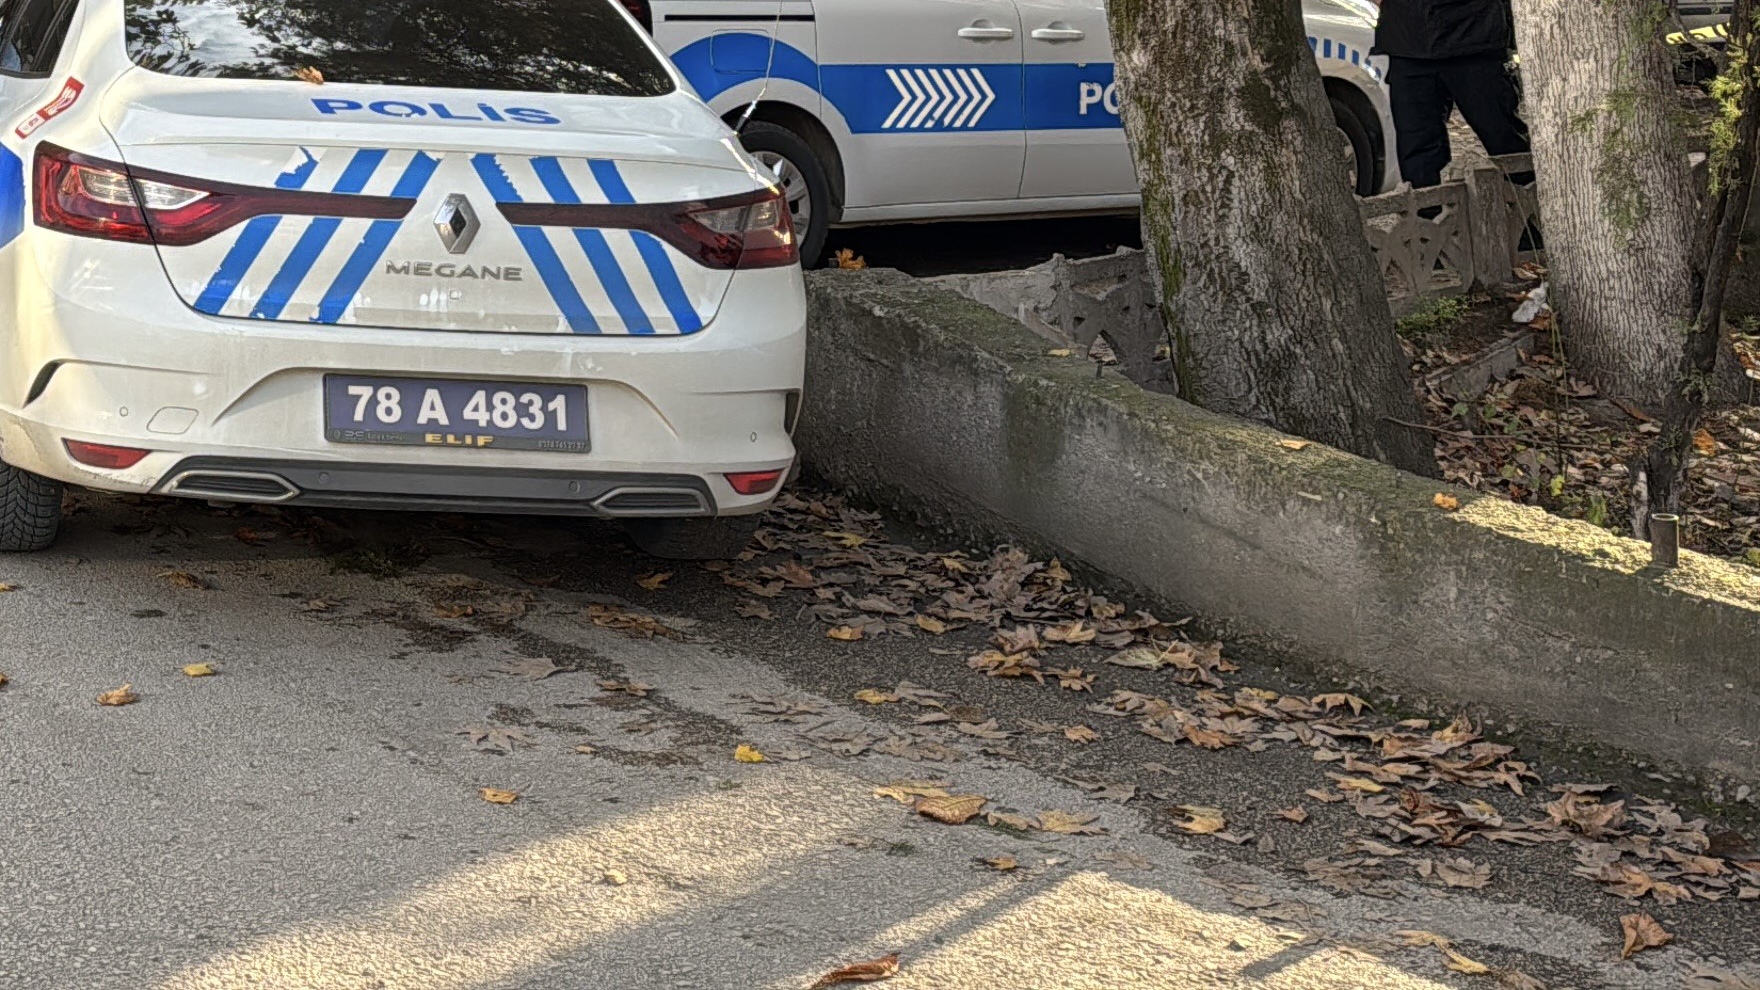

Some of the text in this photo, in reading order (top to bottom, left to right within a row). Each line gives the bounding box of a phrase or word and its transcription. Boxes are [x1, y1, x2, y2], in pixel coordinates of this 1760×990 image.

[310, 98, 561, 125] POLİS
[385, 260, 523, 281] MEGANE
[347, 385, 568, 431] 78 A 4831
